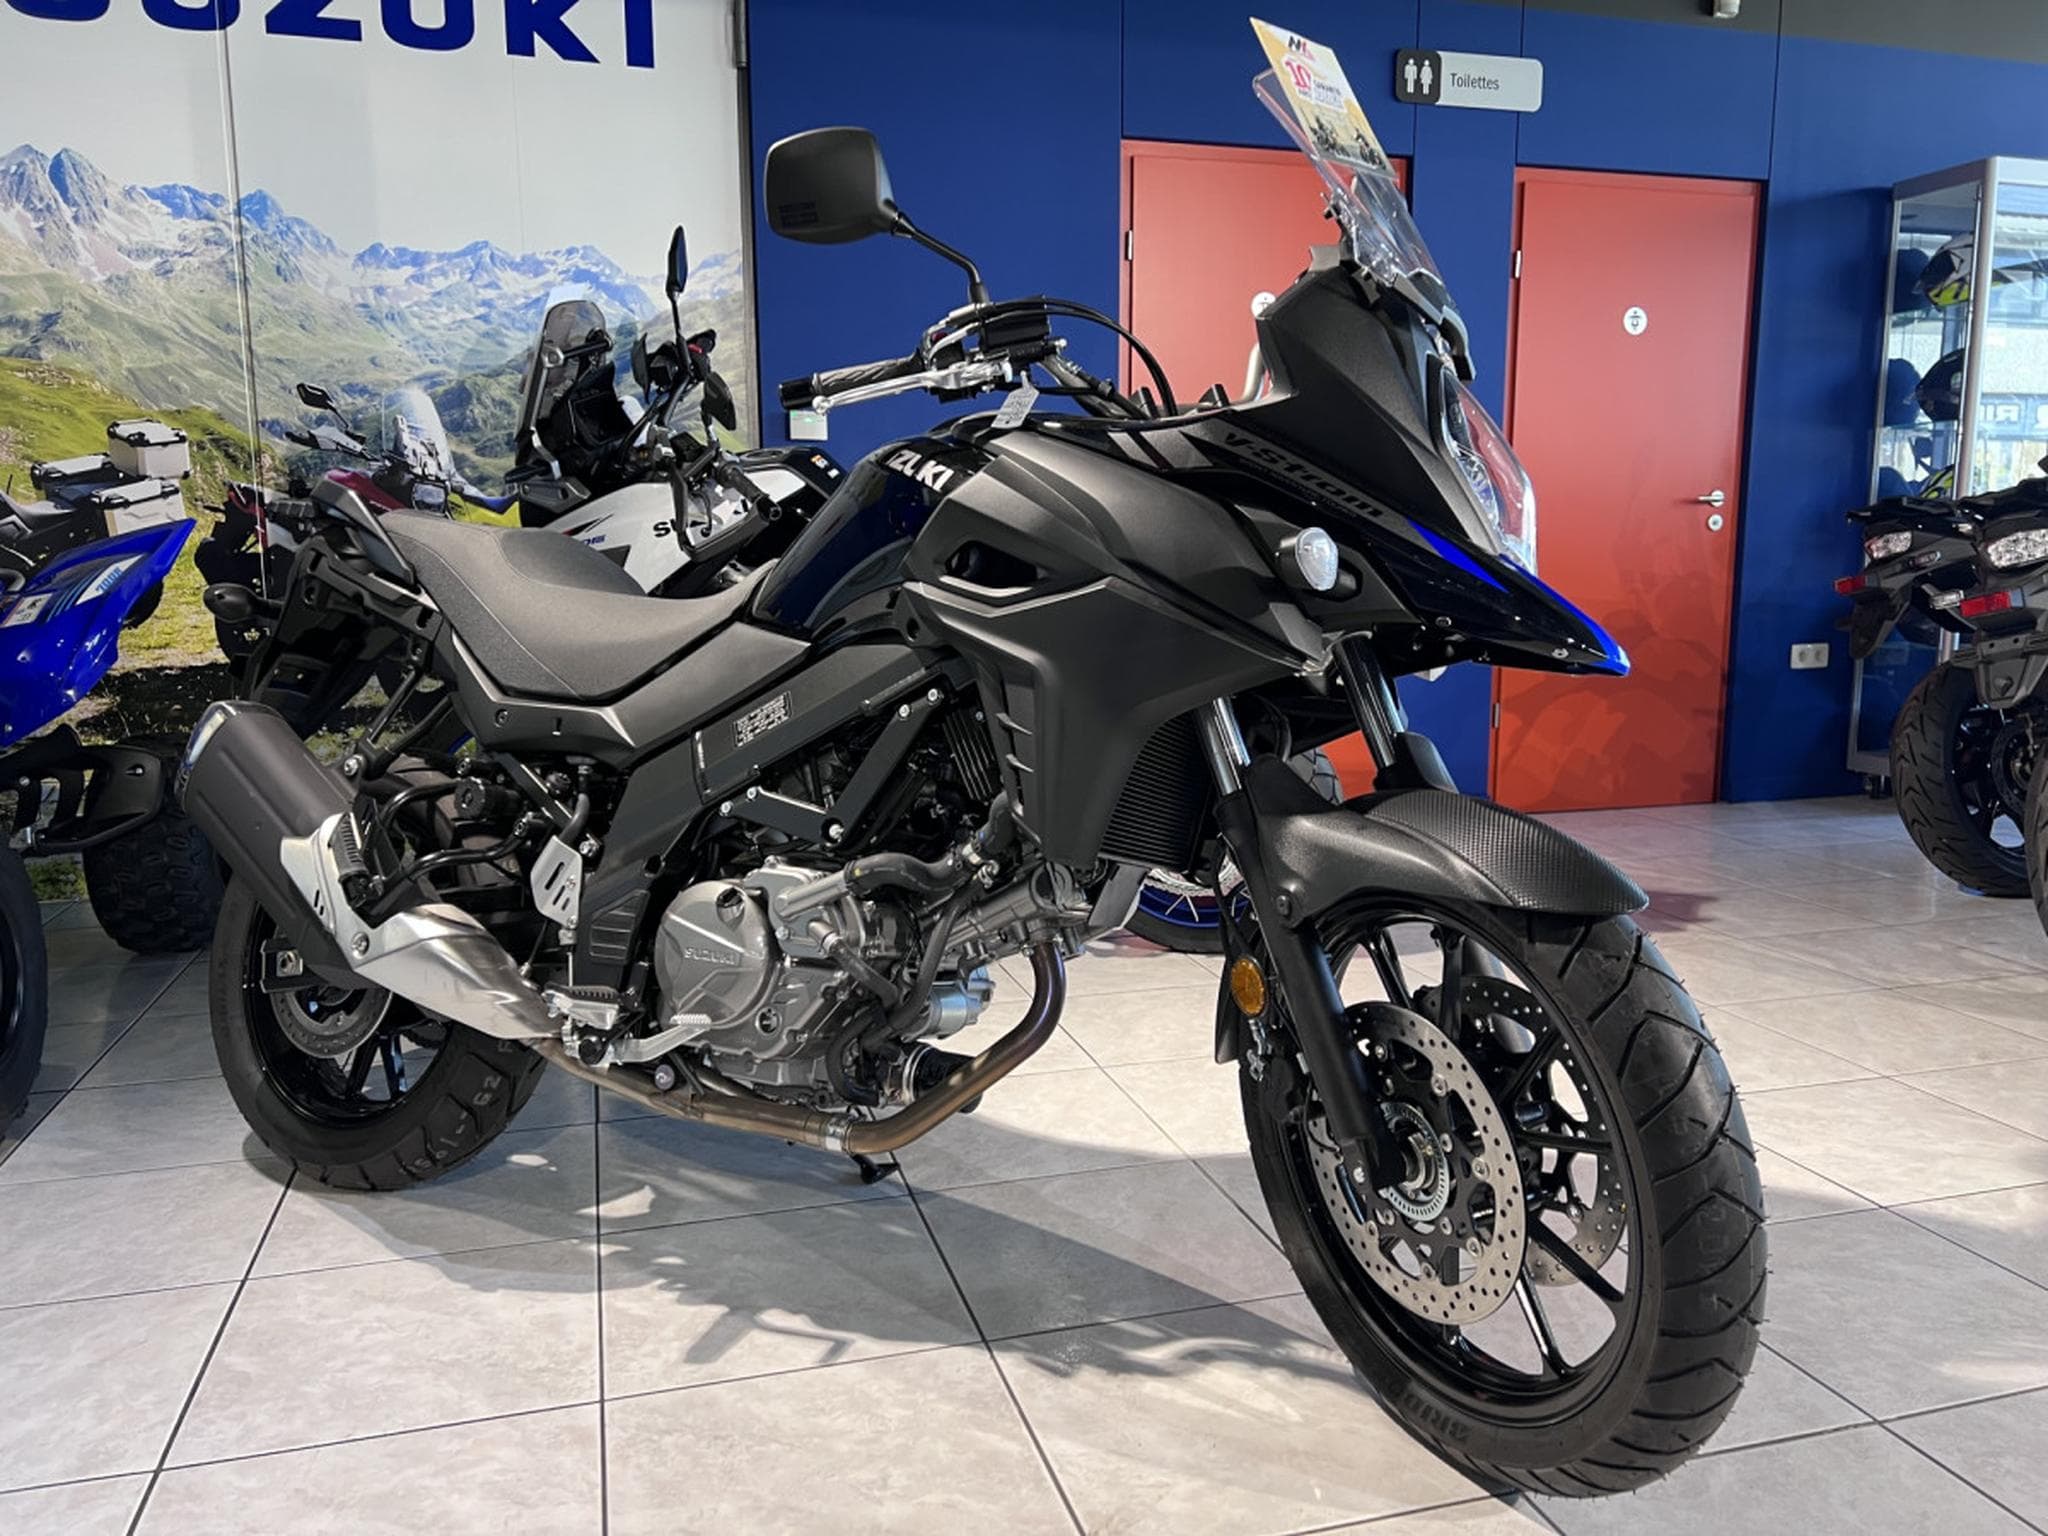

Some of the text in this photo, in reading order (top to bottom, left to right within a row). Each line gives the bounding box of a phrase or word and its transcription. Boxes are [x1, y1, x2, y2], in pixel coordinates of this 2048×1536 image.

[3, 0, 655, 68] ZUKI
[1450, 72, 1500, 91] Toilettes
[886, 449, 954, 492] ZUKI
[1225, 432, 1383, 517] V-Strom
[684, 947, 736, 965] SUZUKI
